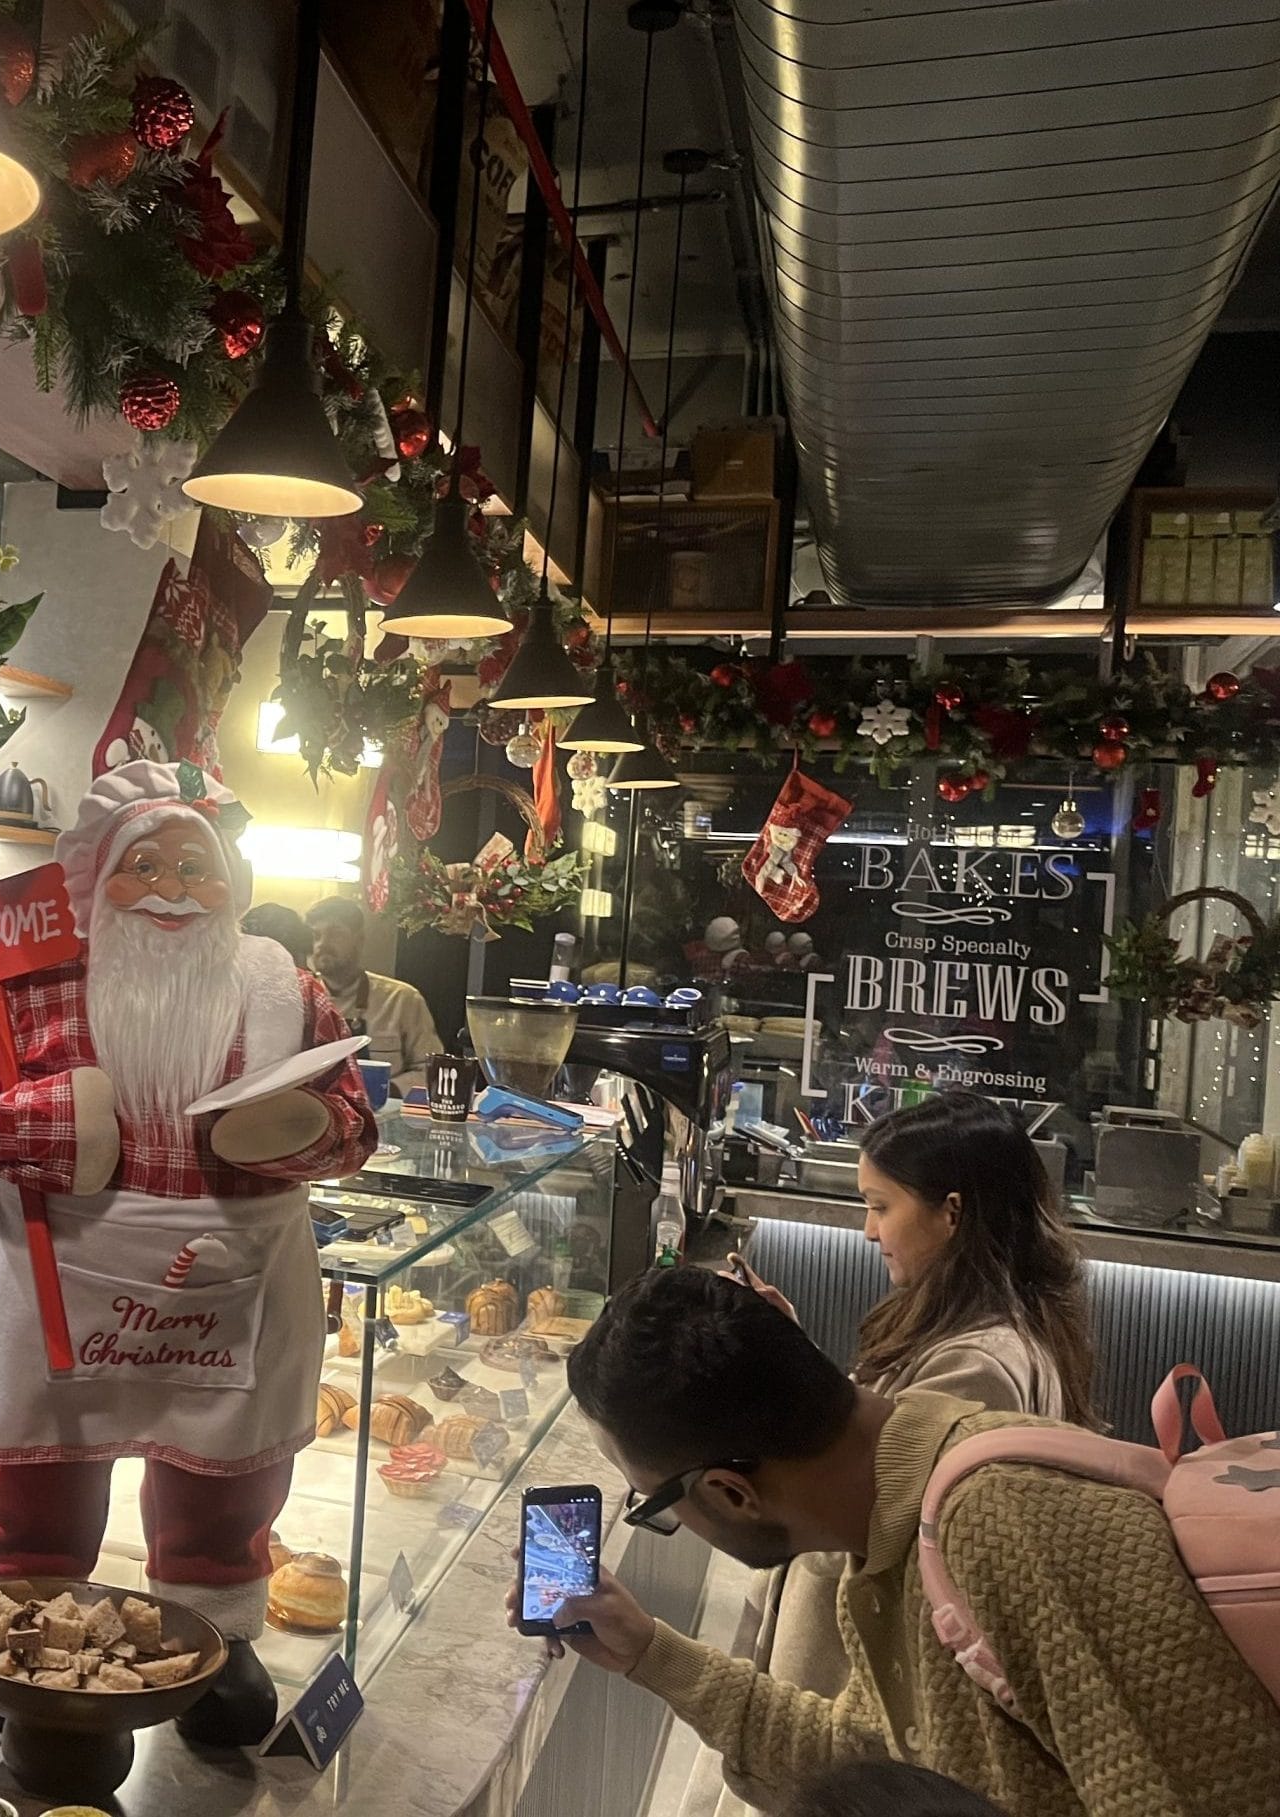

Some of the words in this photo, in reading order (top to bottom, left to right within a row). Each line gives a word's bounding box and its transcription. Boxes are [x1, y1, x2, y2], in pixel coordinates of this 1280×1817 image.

[854, 845, 1075, 900] BAKES
[885, 931, 936, 954] Crisp
[941, 935, 1031, 960] Specialty
[844, 954, 1068, 1026] BREWS
[855, 1056, 908, 1078] Warm
[915, 1064, 931, 1079] &
[937, 1064, 1047, 1093] Engrossing
[113, 1296, 218, 1339] Merry
[79, 1332, 237, 1368] Christmas
[326, 1690, 340, 1712] TRY
[337, 1678, 350, 1697] ME
